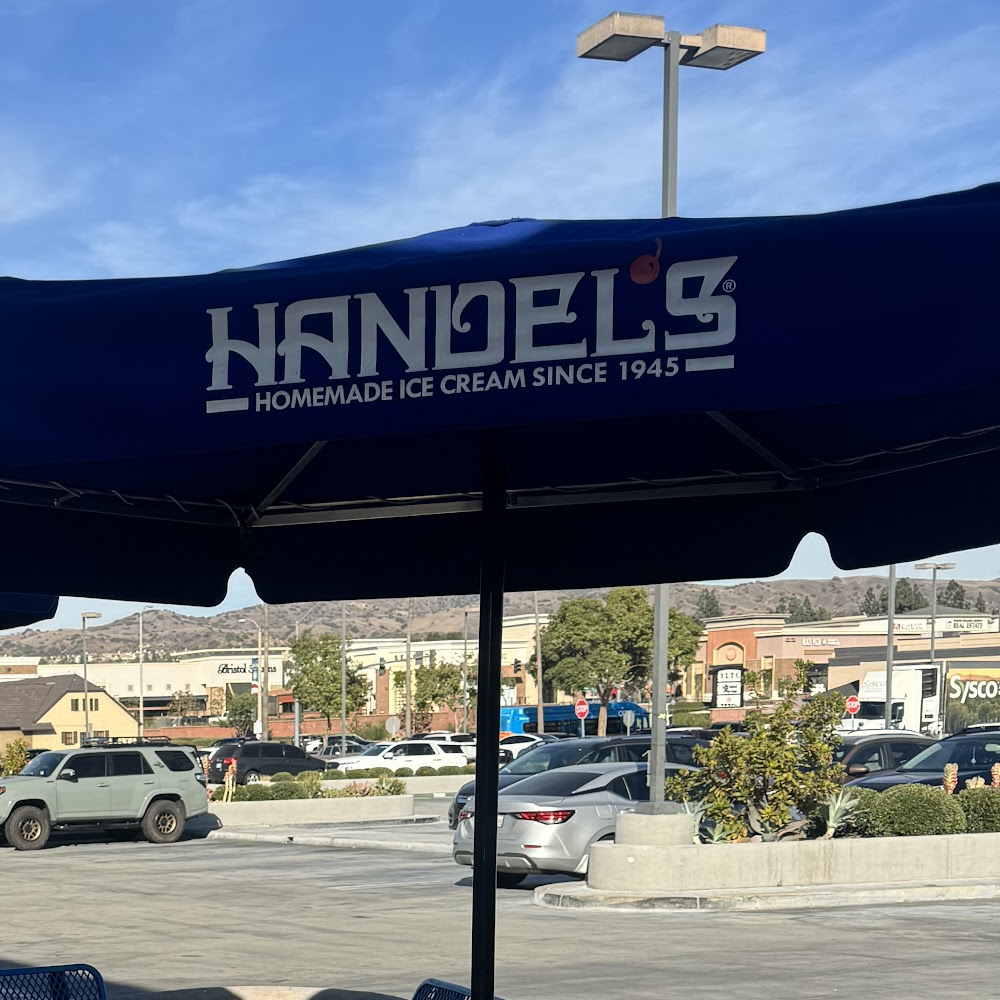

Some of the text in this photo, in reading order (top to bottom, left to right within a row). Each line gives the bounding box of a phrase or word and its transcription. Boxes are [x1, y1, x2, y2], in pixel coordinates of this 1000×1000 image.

[256, 357, 680, 412] HOMEMADE ICE CREAM SINCE 1945
[217, 663, 247, 674] Bristol
[576, 705, 588, 714] STOP
